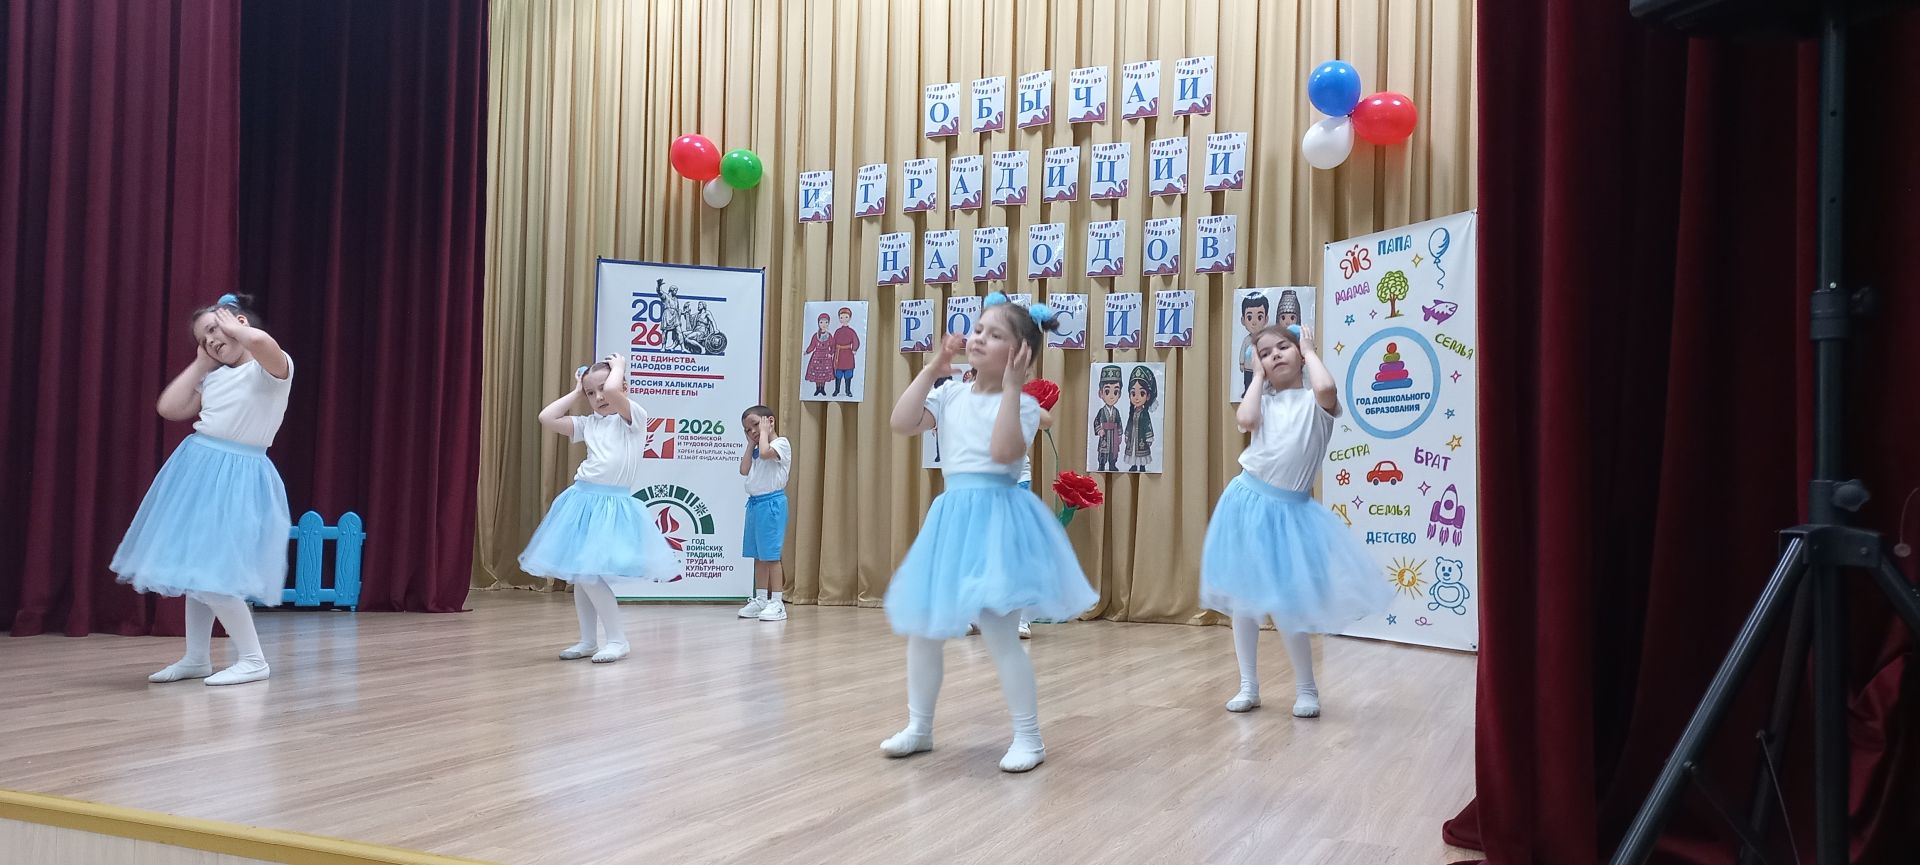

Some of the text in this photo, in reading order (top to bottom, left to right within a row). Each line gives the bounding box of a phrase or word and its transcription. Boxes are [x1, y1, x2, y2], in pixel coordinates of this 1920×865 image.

[929, 77, 1201, 123] ОБЫЧАИ
[859, 151, 1233, 204] ТРАДИЦИИ
[881, 235, 1220, 273] НАРОДОВ
[1378, 235, 1412, 256] ПАПА
[1335, 281, 1371, 305] МАМА
[632, 299, 665, 322] 20
[631, 322, 663, 346] 26
[904, 308, 1183, 342] РОСИИ
[1435, 333, 1474, 360] СЕМЬЯ
[631, 363, 672, 371] НАРОДОВ
[651, 356, 696, 364] ЕДИНСТВА
[630, 388, 680, 396] БЕРДӘМЛЕГЕ
[665, 381, 714, 389] ХАЛЫКЛАРЫ
[1356, 392, 1431, 406] ГОД ДОШКОЛЬНОГО
[1365, 404, 1420, 415] ОБРАЗОВАНИЯ
[678, 419, 725, 435] 2026
[1329, 443, 1370, 462] СЕСТРА
[1413, 446, 1452, 472] БРАТ
[1368, 504, 1411, 516] СЕМЬЯ
[1366, 531, 1417, 545] ДЕТСТВО
